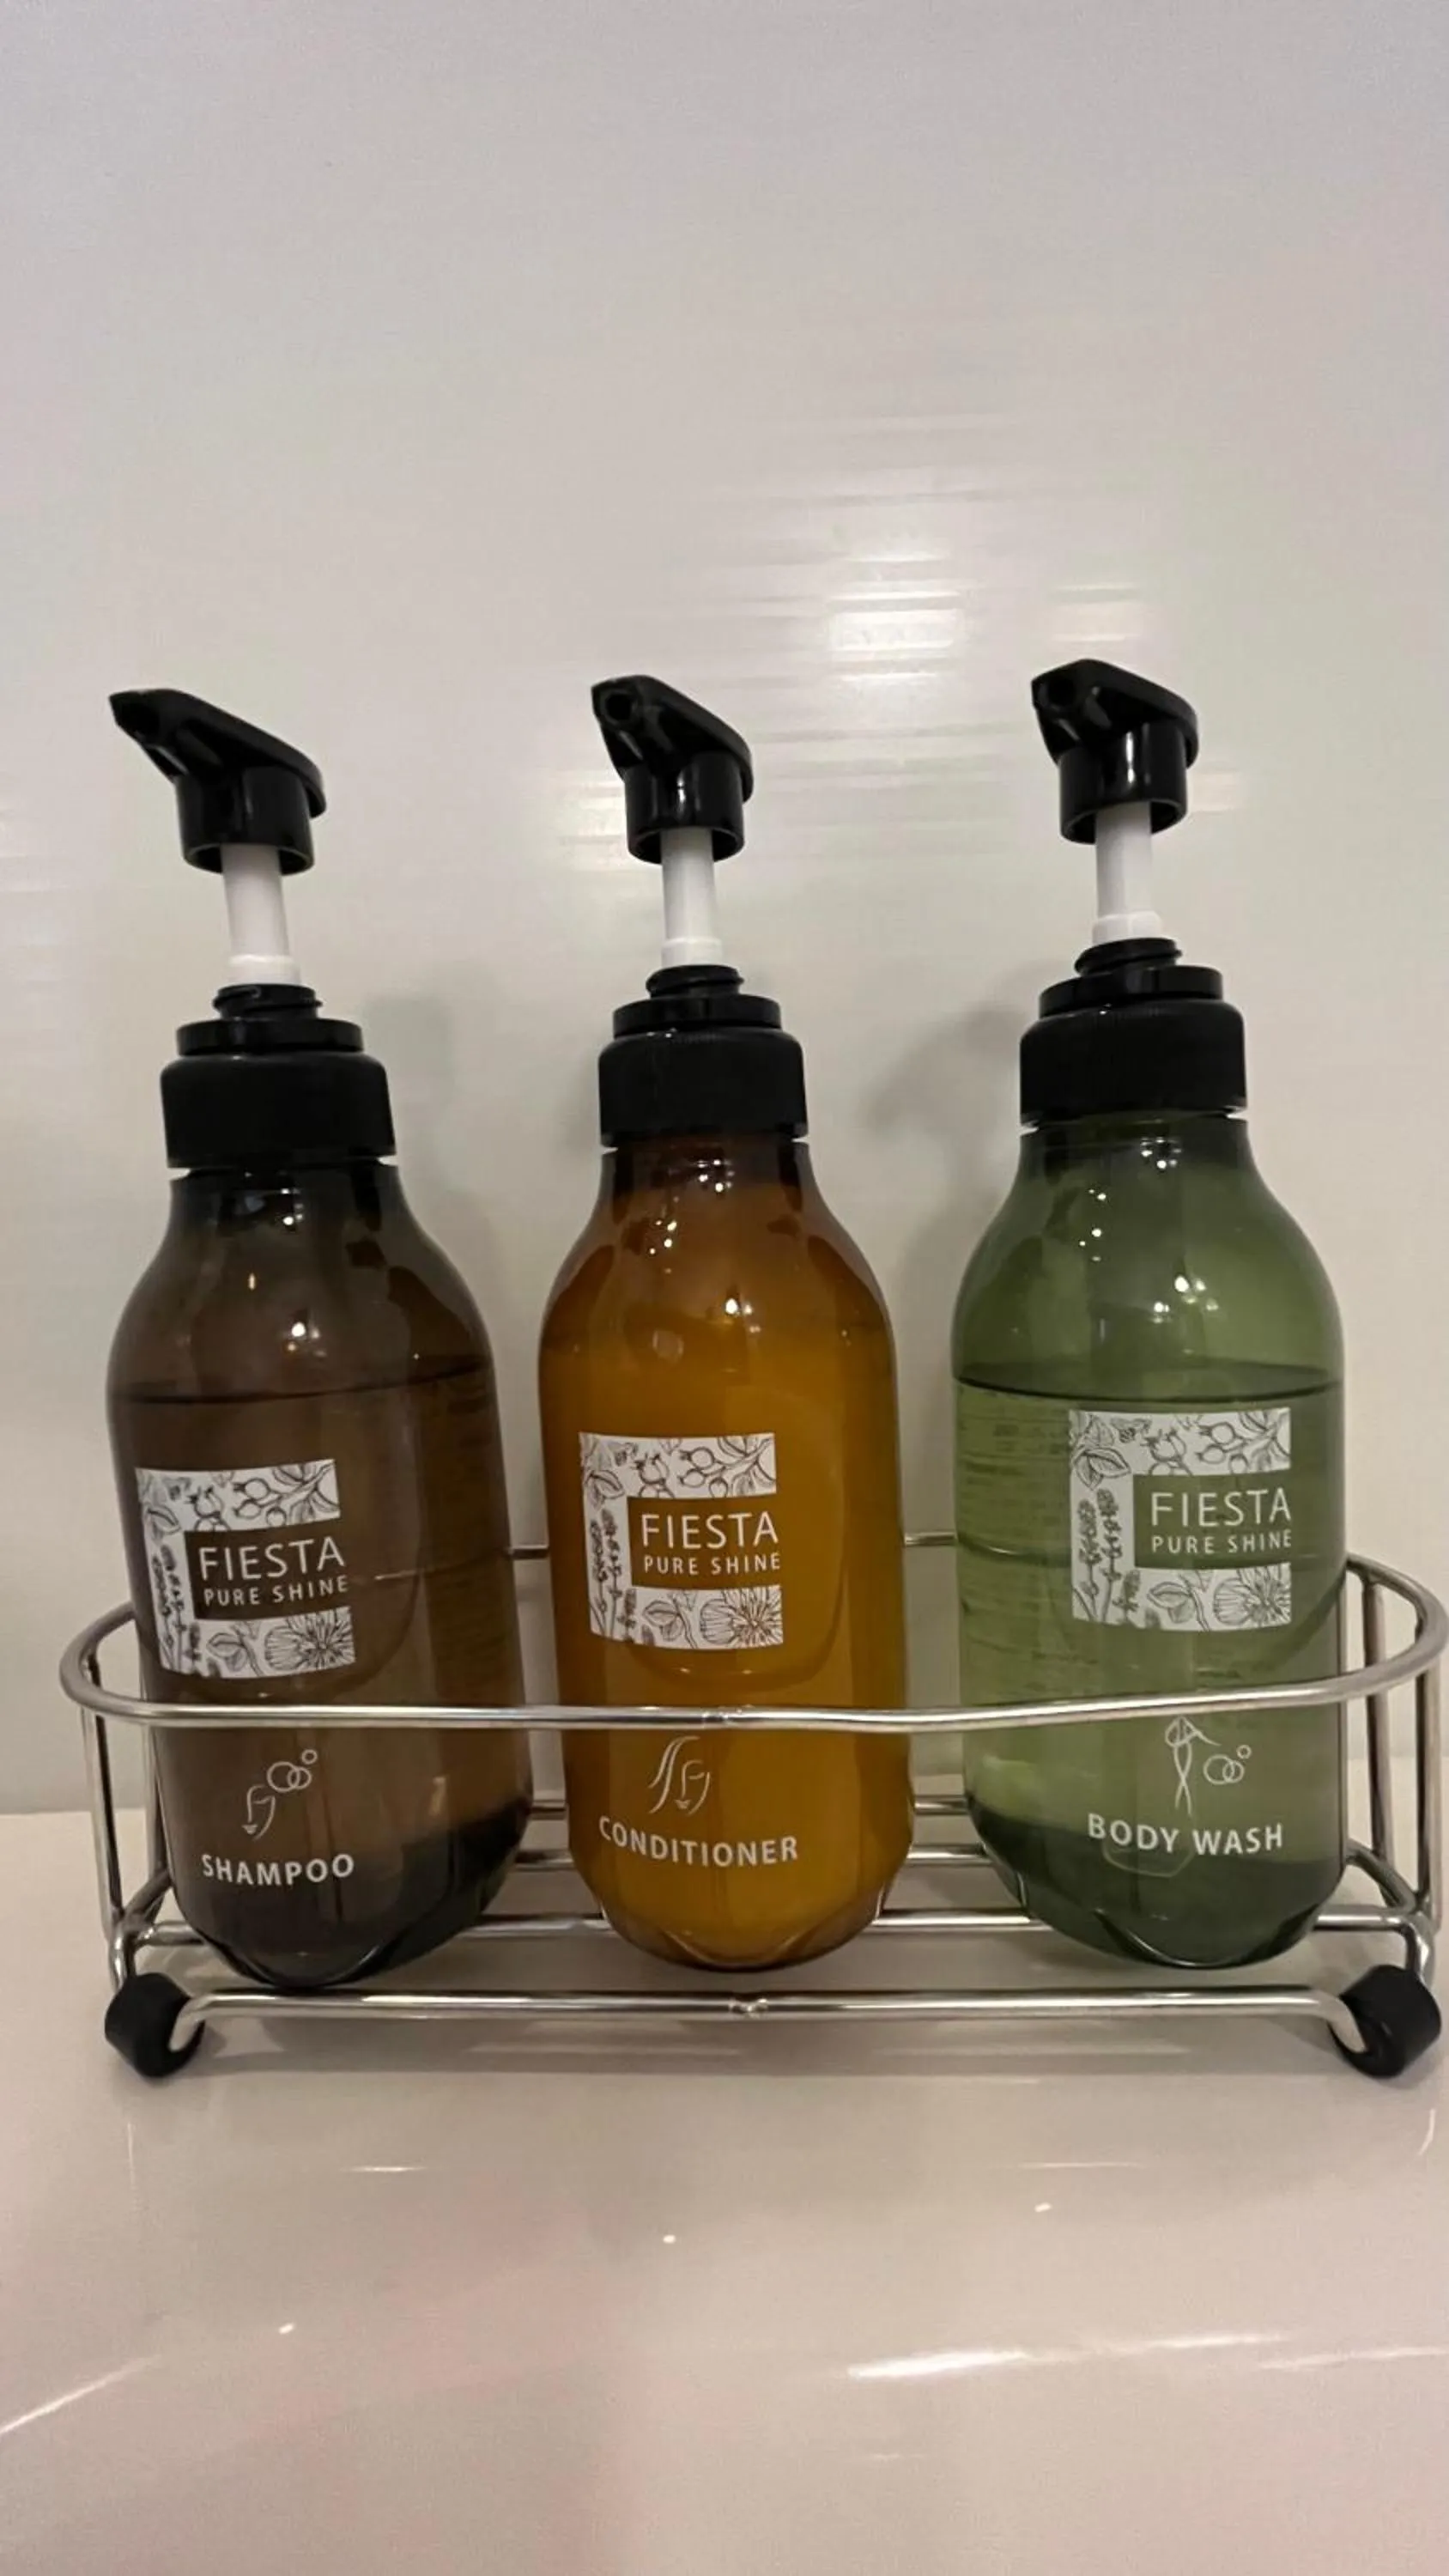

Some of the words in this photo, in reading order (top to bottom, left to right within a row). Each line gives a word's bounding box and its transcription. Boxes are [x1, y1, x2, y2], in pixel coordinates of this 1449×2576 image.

[1151, 1488, 1292, 1527] FIESTA
[641, 1510, 779, 1549] FIESTA
[1152, 1534, 1214, 1554] PURE
[1228, 1530, 1292, 1553] SHINE
[198, 1536, 344, 1582] FIESTA
[643, 1554, 699, 1576] PURE
[711, 1552, 781, 1575] SHINE
[203, 1585, 261, 1607] PURE
[272, 1575, 349, 1603] SHINE
[599, 1814, 798, 1868] CONDITIONER
[1088, 1813, 1179, 1854] BODY
[1192, 1824, 1283, 1856] WASH
[201, 1853, 355, 1887] SHAMPOO
